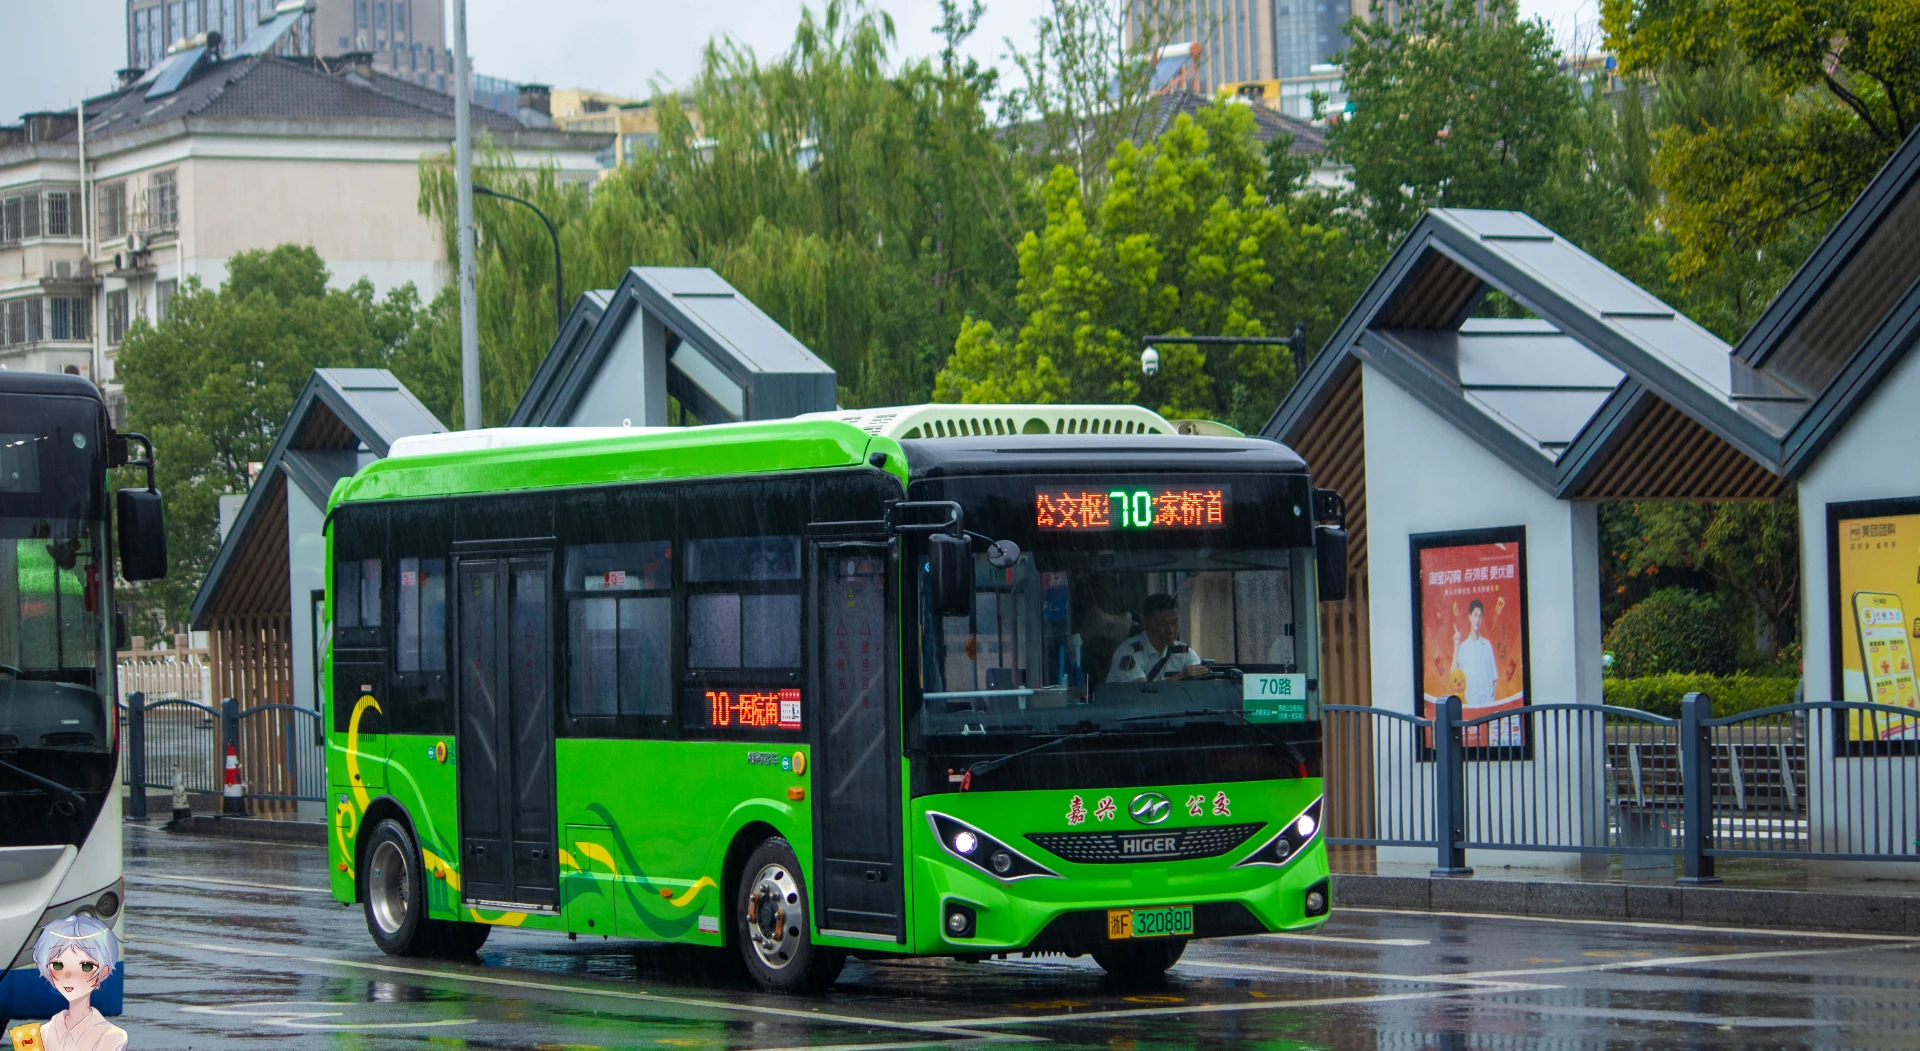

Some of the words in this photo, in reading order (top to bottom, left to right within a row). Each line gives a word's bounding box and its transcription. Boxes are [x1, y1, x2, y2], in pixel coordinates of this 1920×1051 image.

[1037, 492, 1109, 528] 公交枢
[1110, 491, 1151, 527] 70
[1152, 490, 1222, 526] 家桥首
[1862, 523, 1896, 537] 美团团购
[1428, 568, 1462, 586] 淘宝闪购
[1464, 566, 1489, 582] 点外卖
[1490, 563, 1515, 580] 更优惠
[1259, 678, 1292, 695] 70路
[1065, 796, 1118, 826] 嘉兴
[1185, 790, 1232, 817] 公交
[1123, 837, 1177, 853] HIGER
[1137, 910, 1192, 935] 32088D
